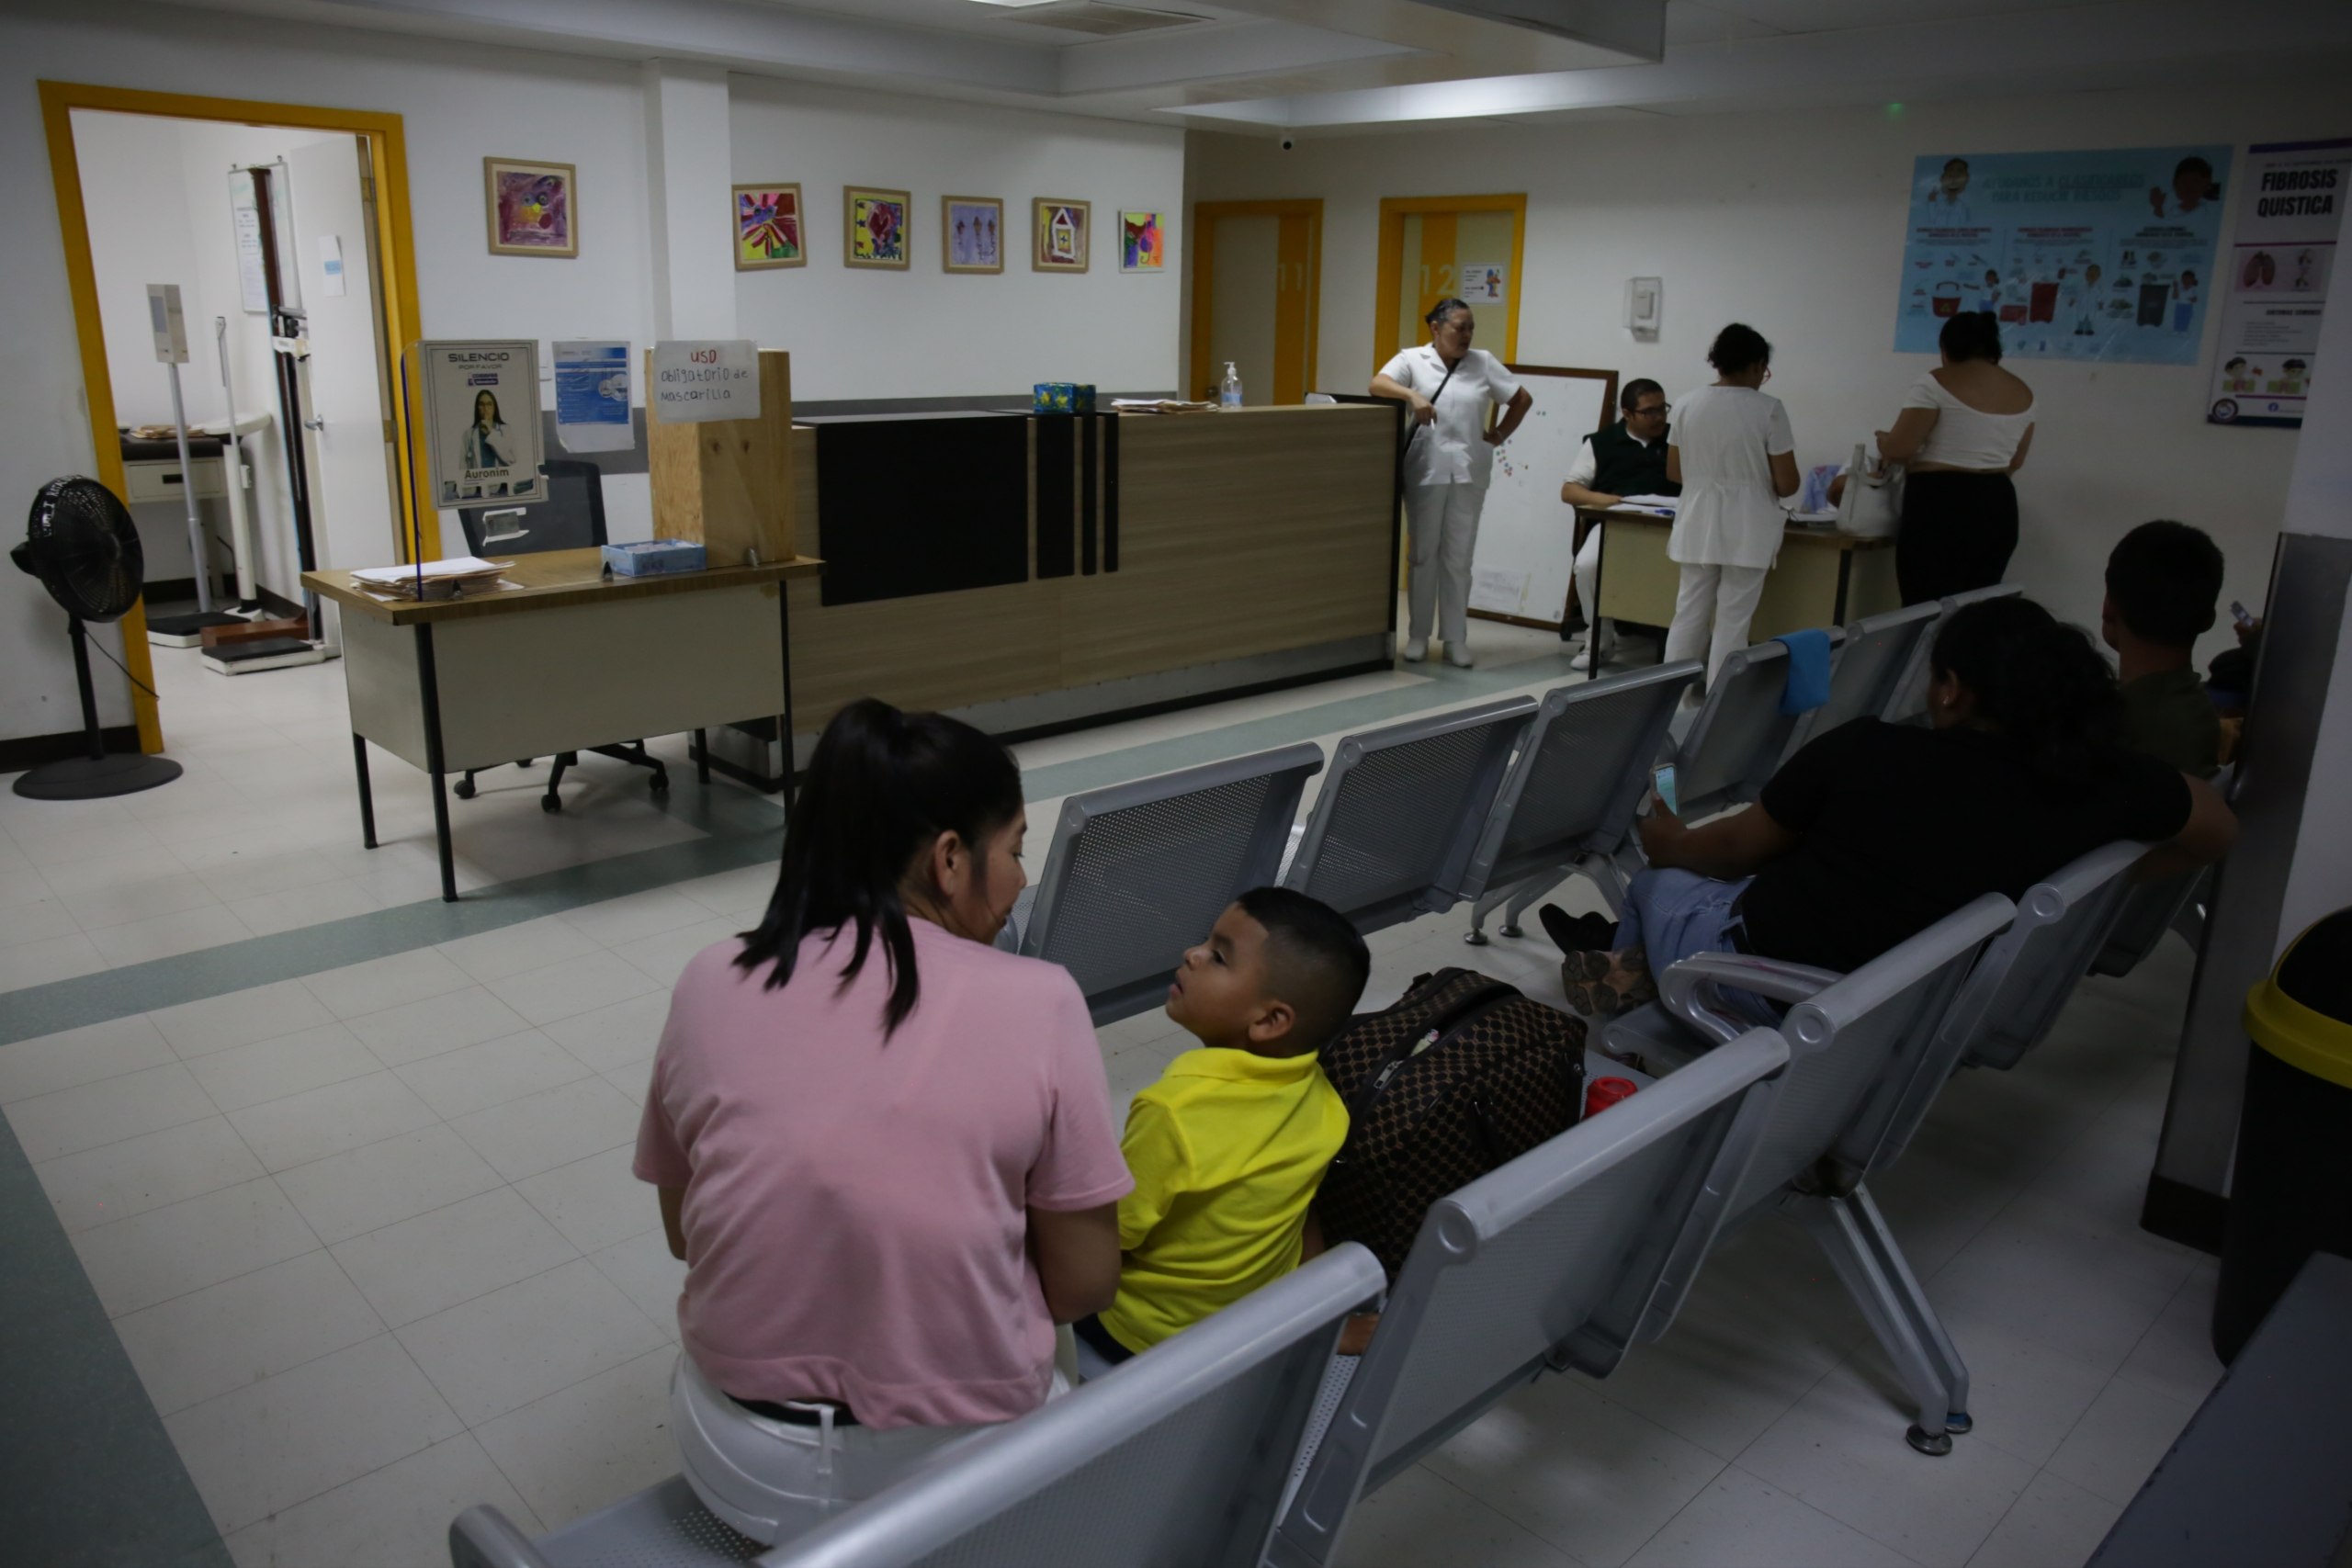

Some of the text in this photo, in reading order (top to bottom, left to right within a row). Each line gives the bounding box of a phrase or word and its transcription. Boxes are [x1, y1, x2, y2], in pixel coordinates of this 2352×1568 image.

[2261, 169, 2338, 191] FIBROSIS
[2257, 195, 2335, 218] QUISTICA
[1419, 264, 1454, 295] 12
[448, 352, 510, 363] SILENCIO
[733, 369, 750, 379] de
[464, 468, 510, 479] Auronim
